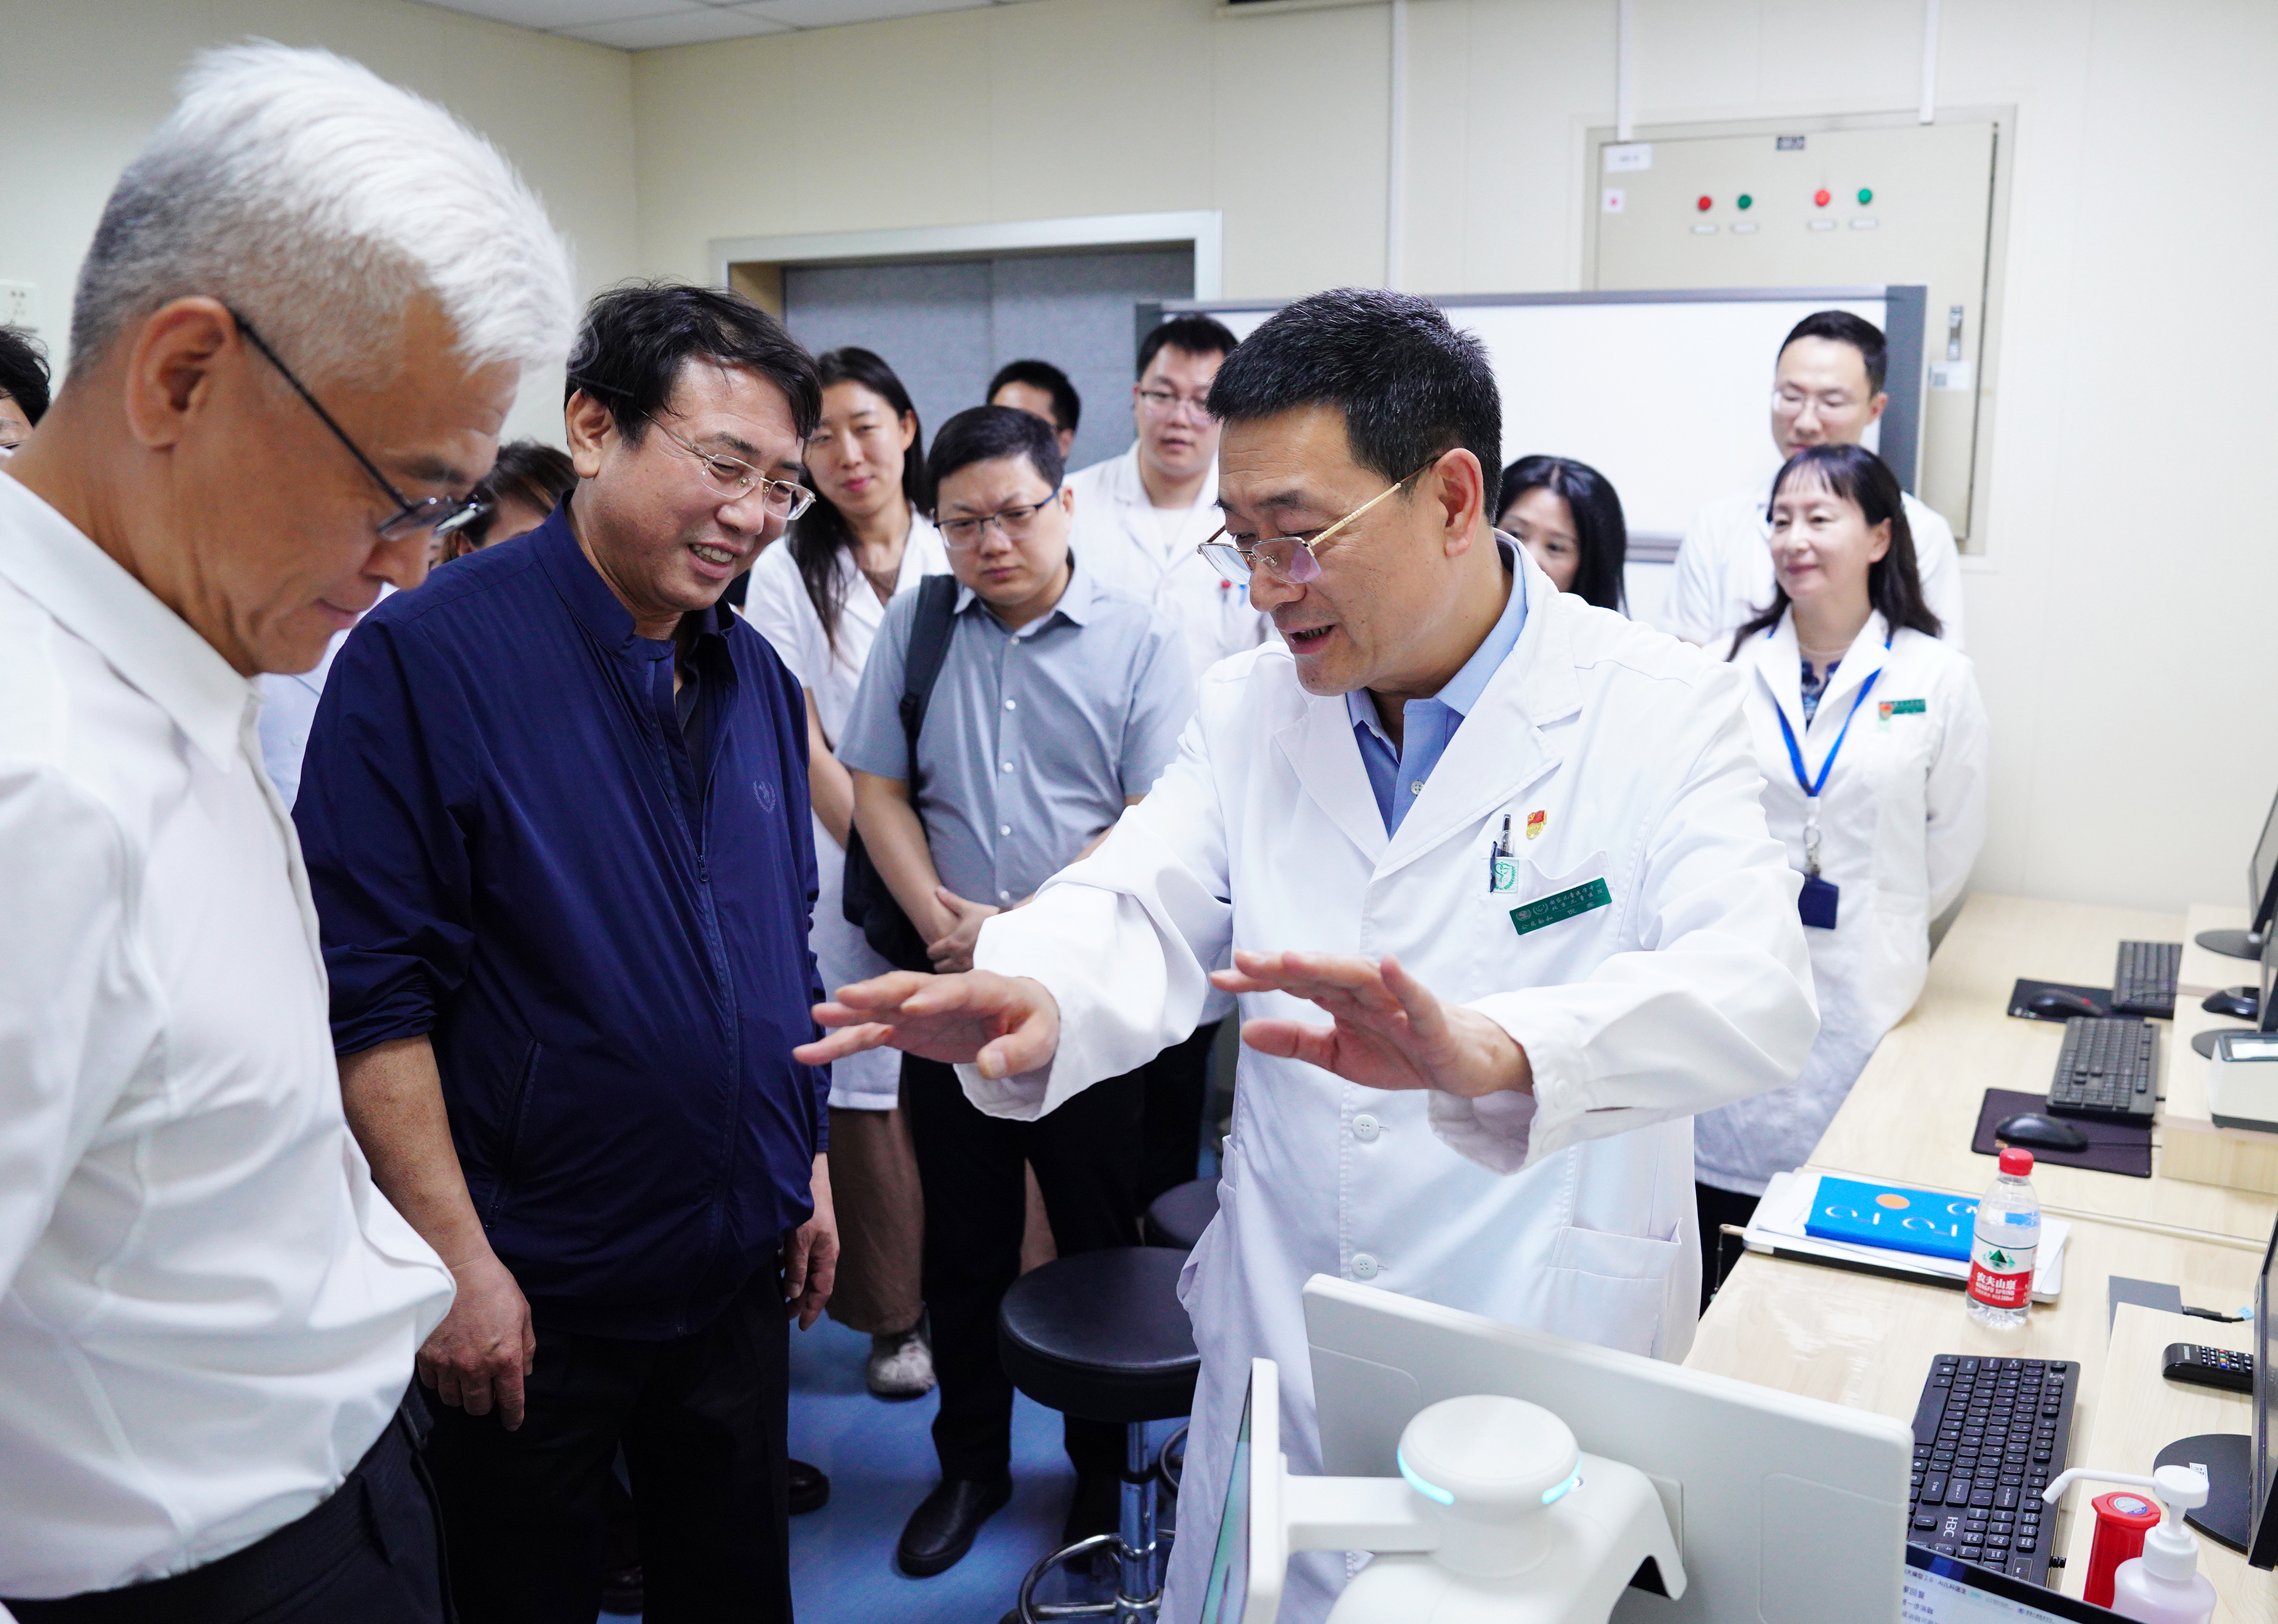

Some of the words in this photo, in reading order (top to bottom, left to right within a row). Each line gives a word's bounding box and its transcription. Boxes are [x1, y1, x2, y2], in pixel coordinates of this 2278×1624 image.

[1975, 1281, 1995, 1293] NONGFU
[1995, 1288, 2015, 1296] SPRING
[1977, 1271, 2016, 1290] 农夫山泉
[1943, 1516, 1958, 1537] H3C
